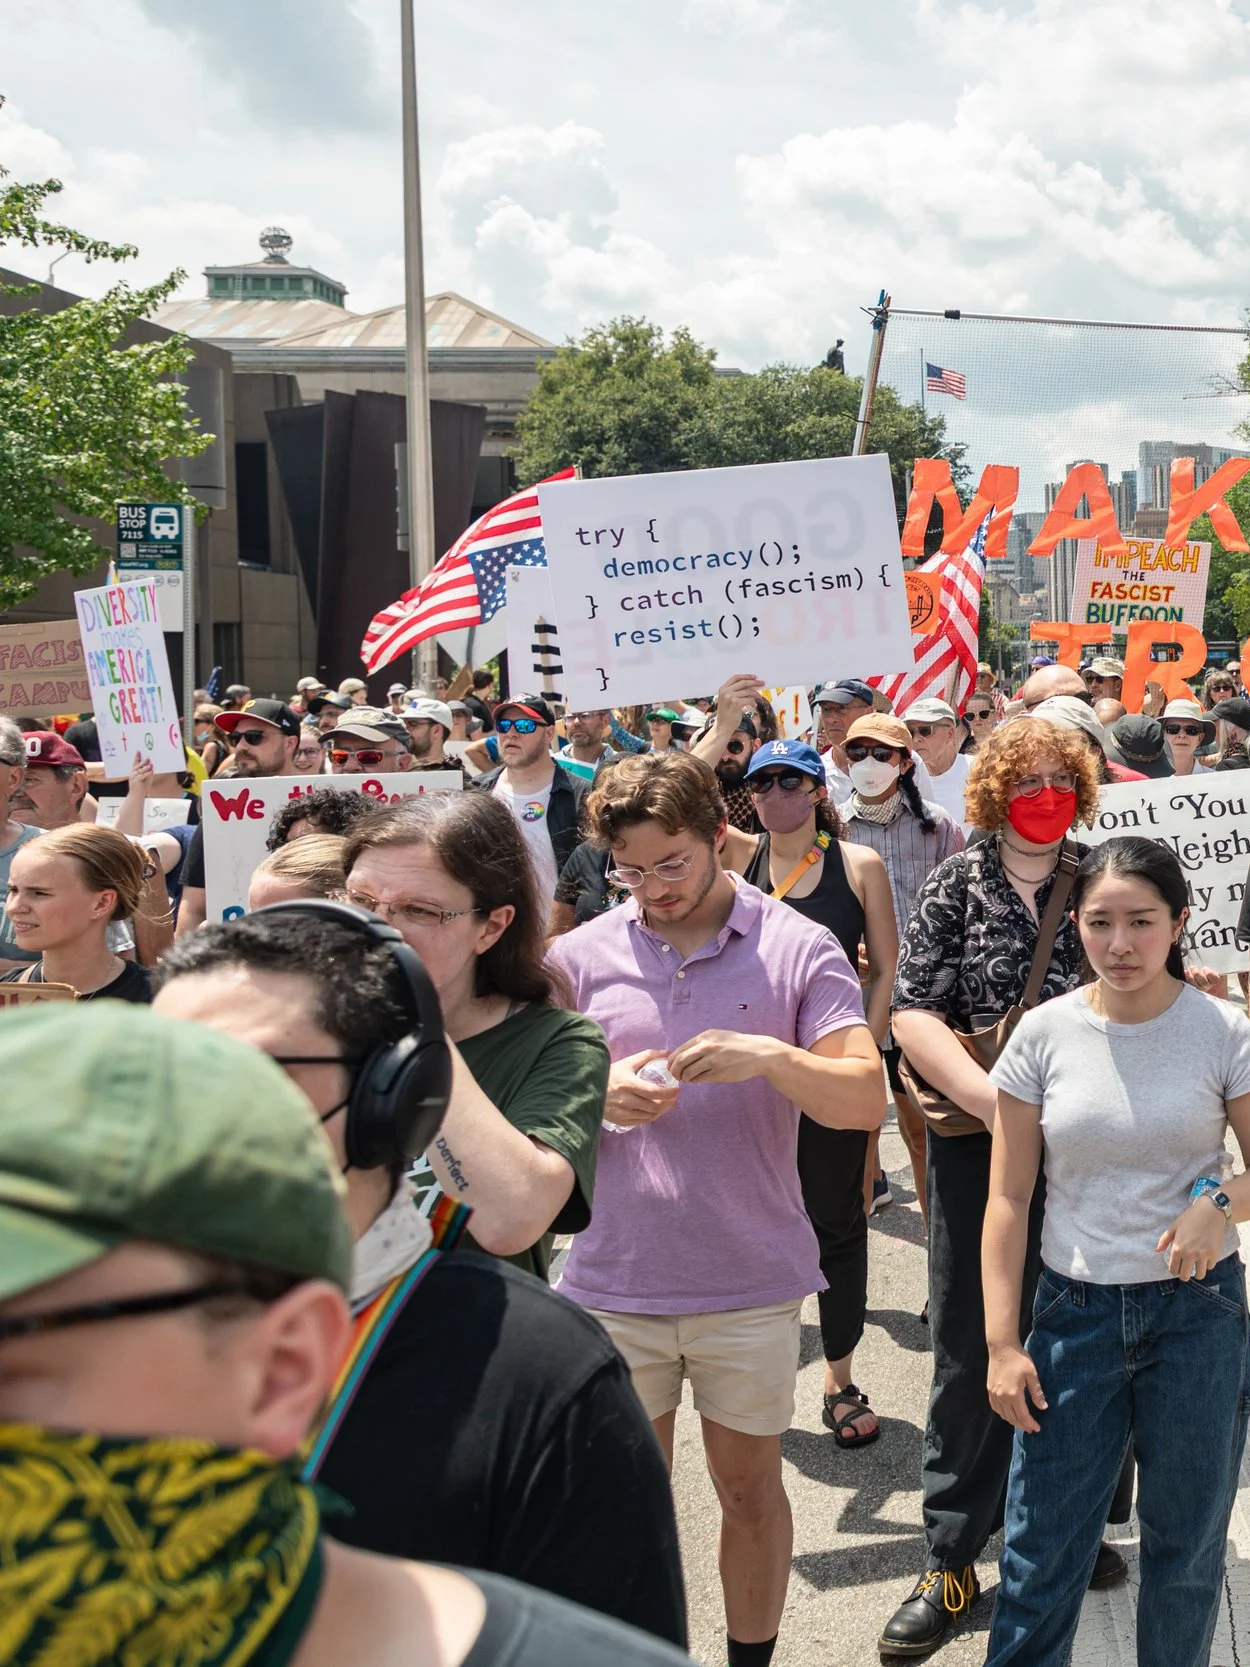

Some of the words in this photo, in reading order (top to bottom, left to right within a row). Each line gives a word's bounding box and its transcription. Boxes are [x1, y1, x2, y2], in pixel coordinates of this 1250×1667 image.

[119, 507, 146, 518] BUS
[120, 519, 146, 528] STOP
[122, 531, 143, 539] 7115
[575, 526, 625, 548] try
[646, 519, 659, 542] {
[603, 541, 801, 579] democracy();
[1122, 570, 1145, 581] THE
[585, 595, 598, 619] }
[620, 585, 703, 611] catch
[724, 567, 864, 604] (fascism)
[879, 564, 891, 587] {
[1090, 581, 1175, 603] FASCIST
[80, 584, 157, 632] DIVERSITY
[1086, 602, 1184, 626] BUFFOON
[614, 614, 760, 647] resist();
[0, 640, 84, 670] FACIS
[88, 649, 157, 687] AMERICA
[0, 680, 92, 708] AMPU
[596, 668, 610, 692] }
[109, 686, 165, 725] GREAT!
[771, 741, 788, 755] LA
[210, 788, 265, 821] We
[1170, 792, 1247, 820] You
